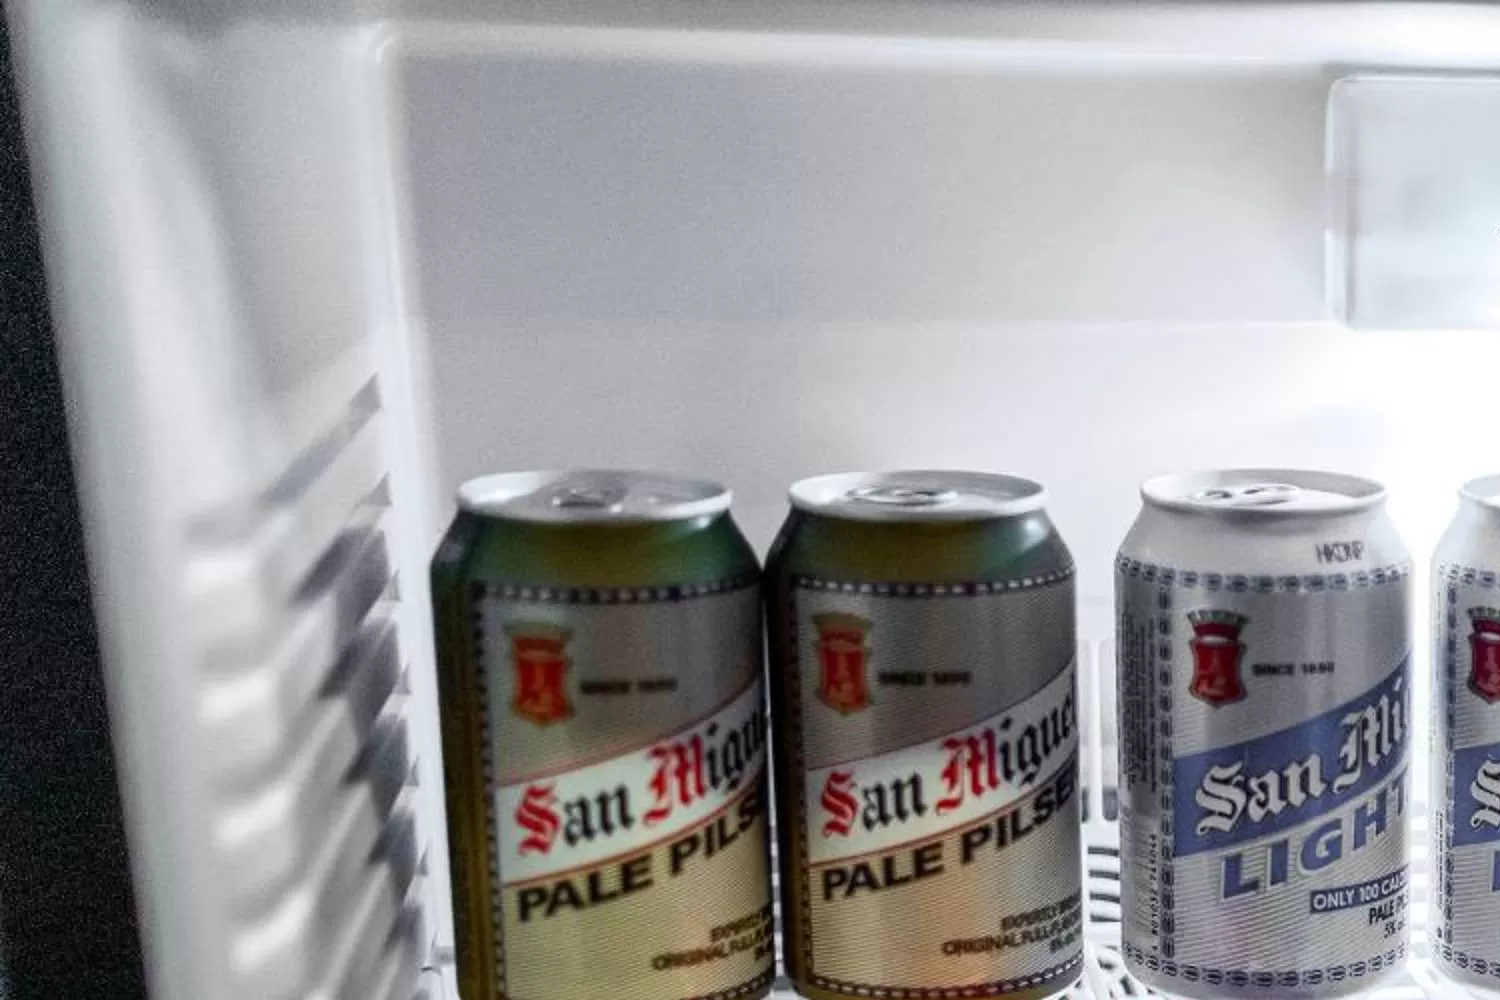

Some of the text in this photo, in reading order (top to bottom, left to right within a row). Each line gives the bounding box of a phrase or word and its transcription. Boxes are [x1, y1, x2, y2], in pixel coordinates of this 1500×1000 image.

[514, 781, 635, 856] San
[821, 770, 928, 838] San
[1195, 752, 1327, 837] San
[1221, 770, 1406, 901] LIGHT
[517, 853, 653, 923] PALE
[822, 841, 945, 901] PALE
[1313, 889, 1355, 910] ONLY
[1359, 883, 1379, 902] 100
